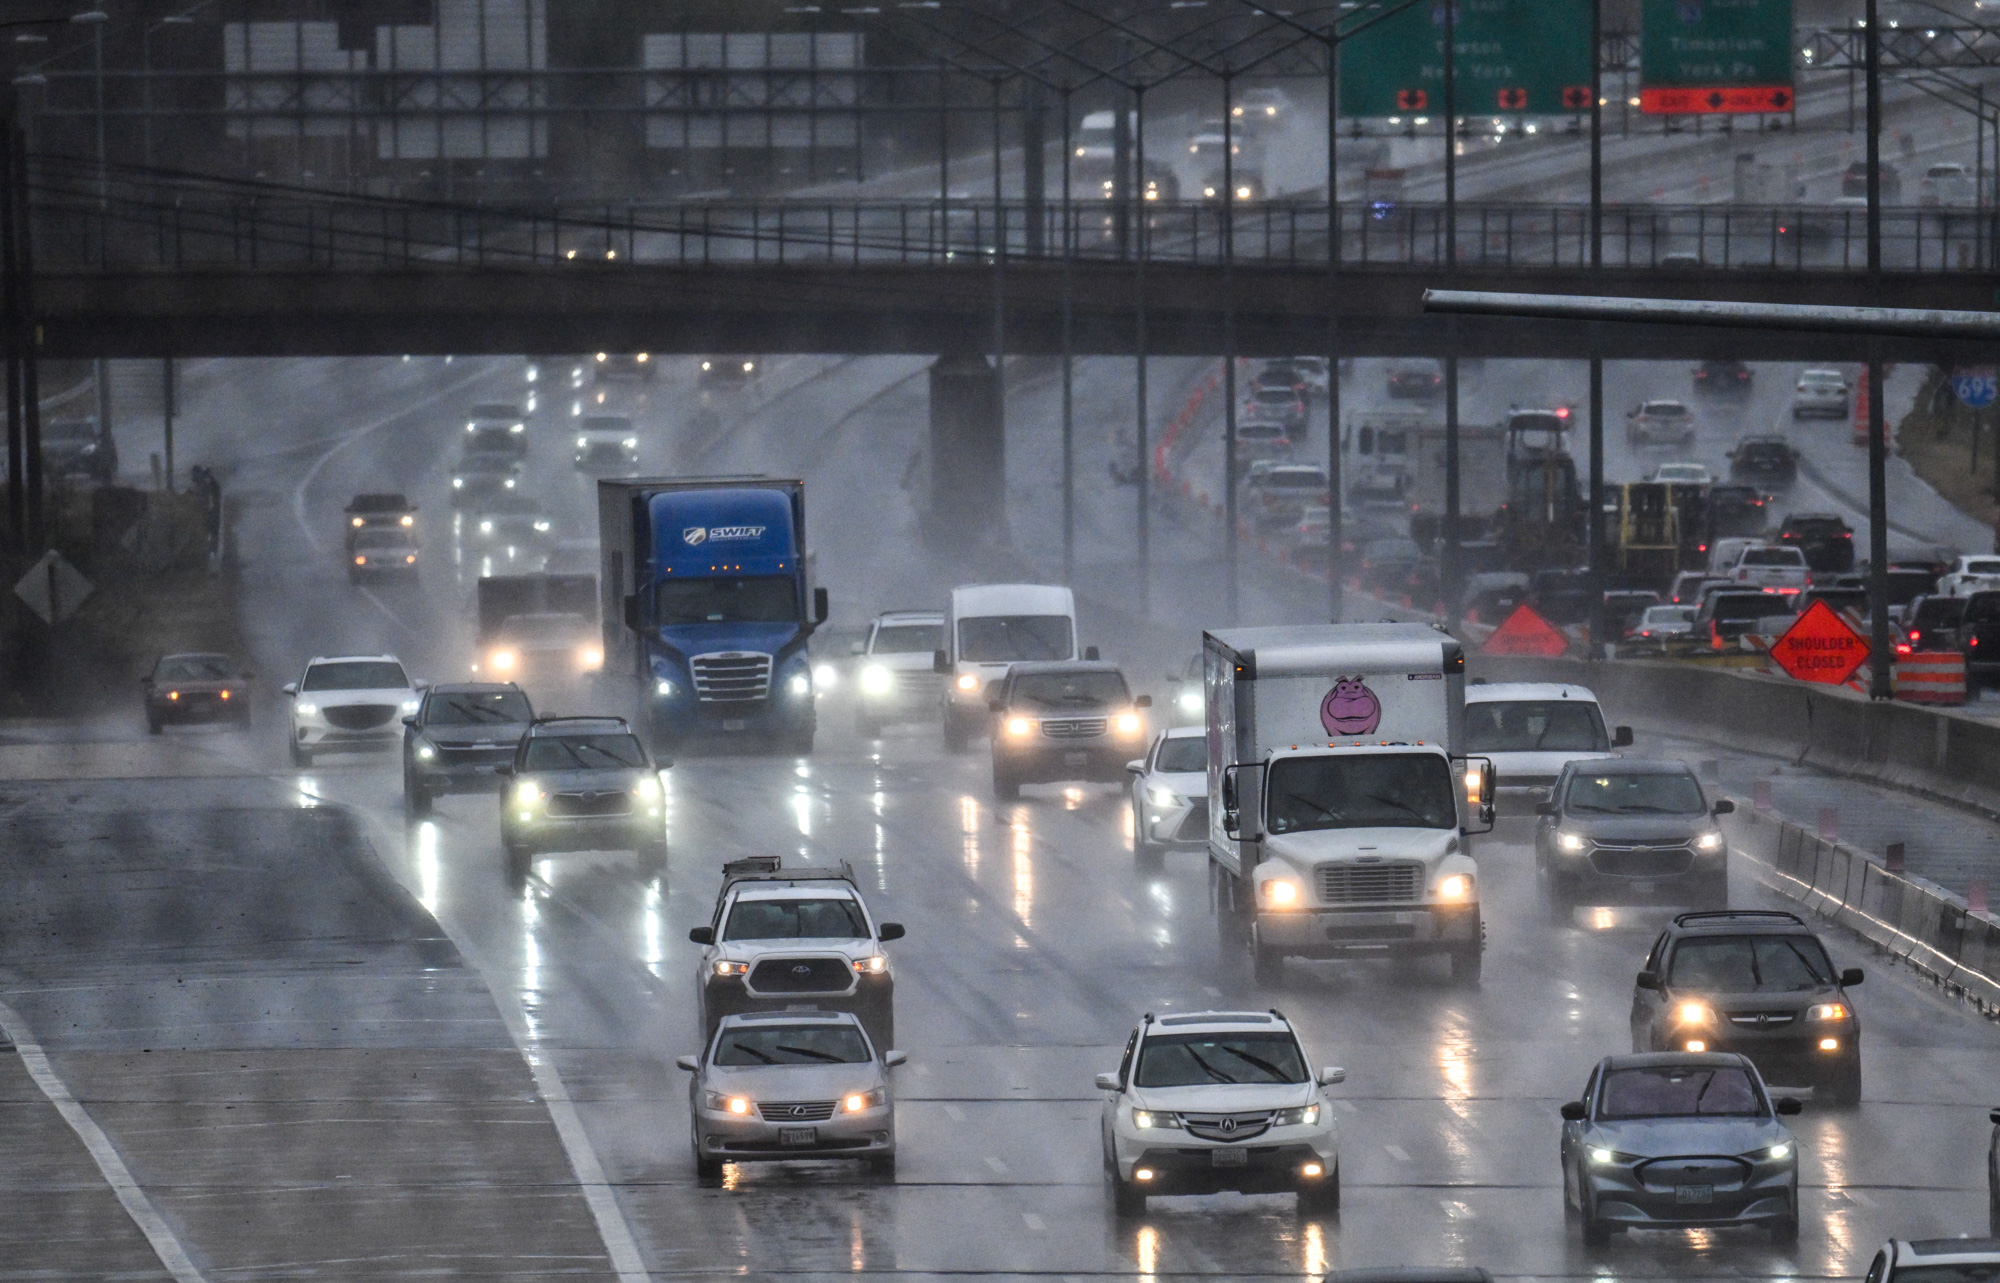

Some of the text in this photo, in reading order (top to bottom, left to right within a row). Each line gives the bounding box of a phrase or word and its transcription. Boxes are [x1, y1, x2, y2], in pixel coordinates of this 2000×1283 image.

[1435, 40, 1501, 54] Twson
[1959, 376, 1997, 399] 695
[710, 527, 765, 538] SWIFT
[1787, 637, 1854, 650] SHOULDER
[1796, 655, 1846, 670] CLOSED
